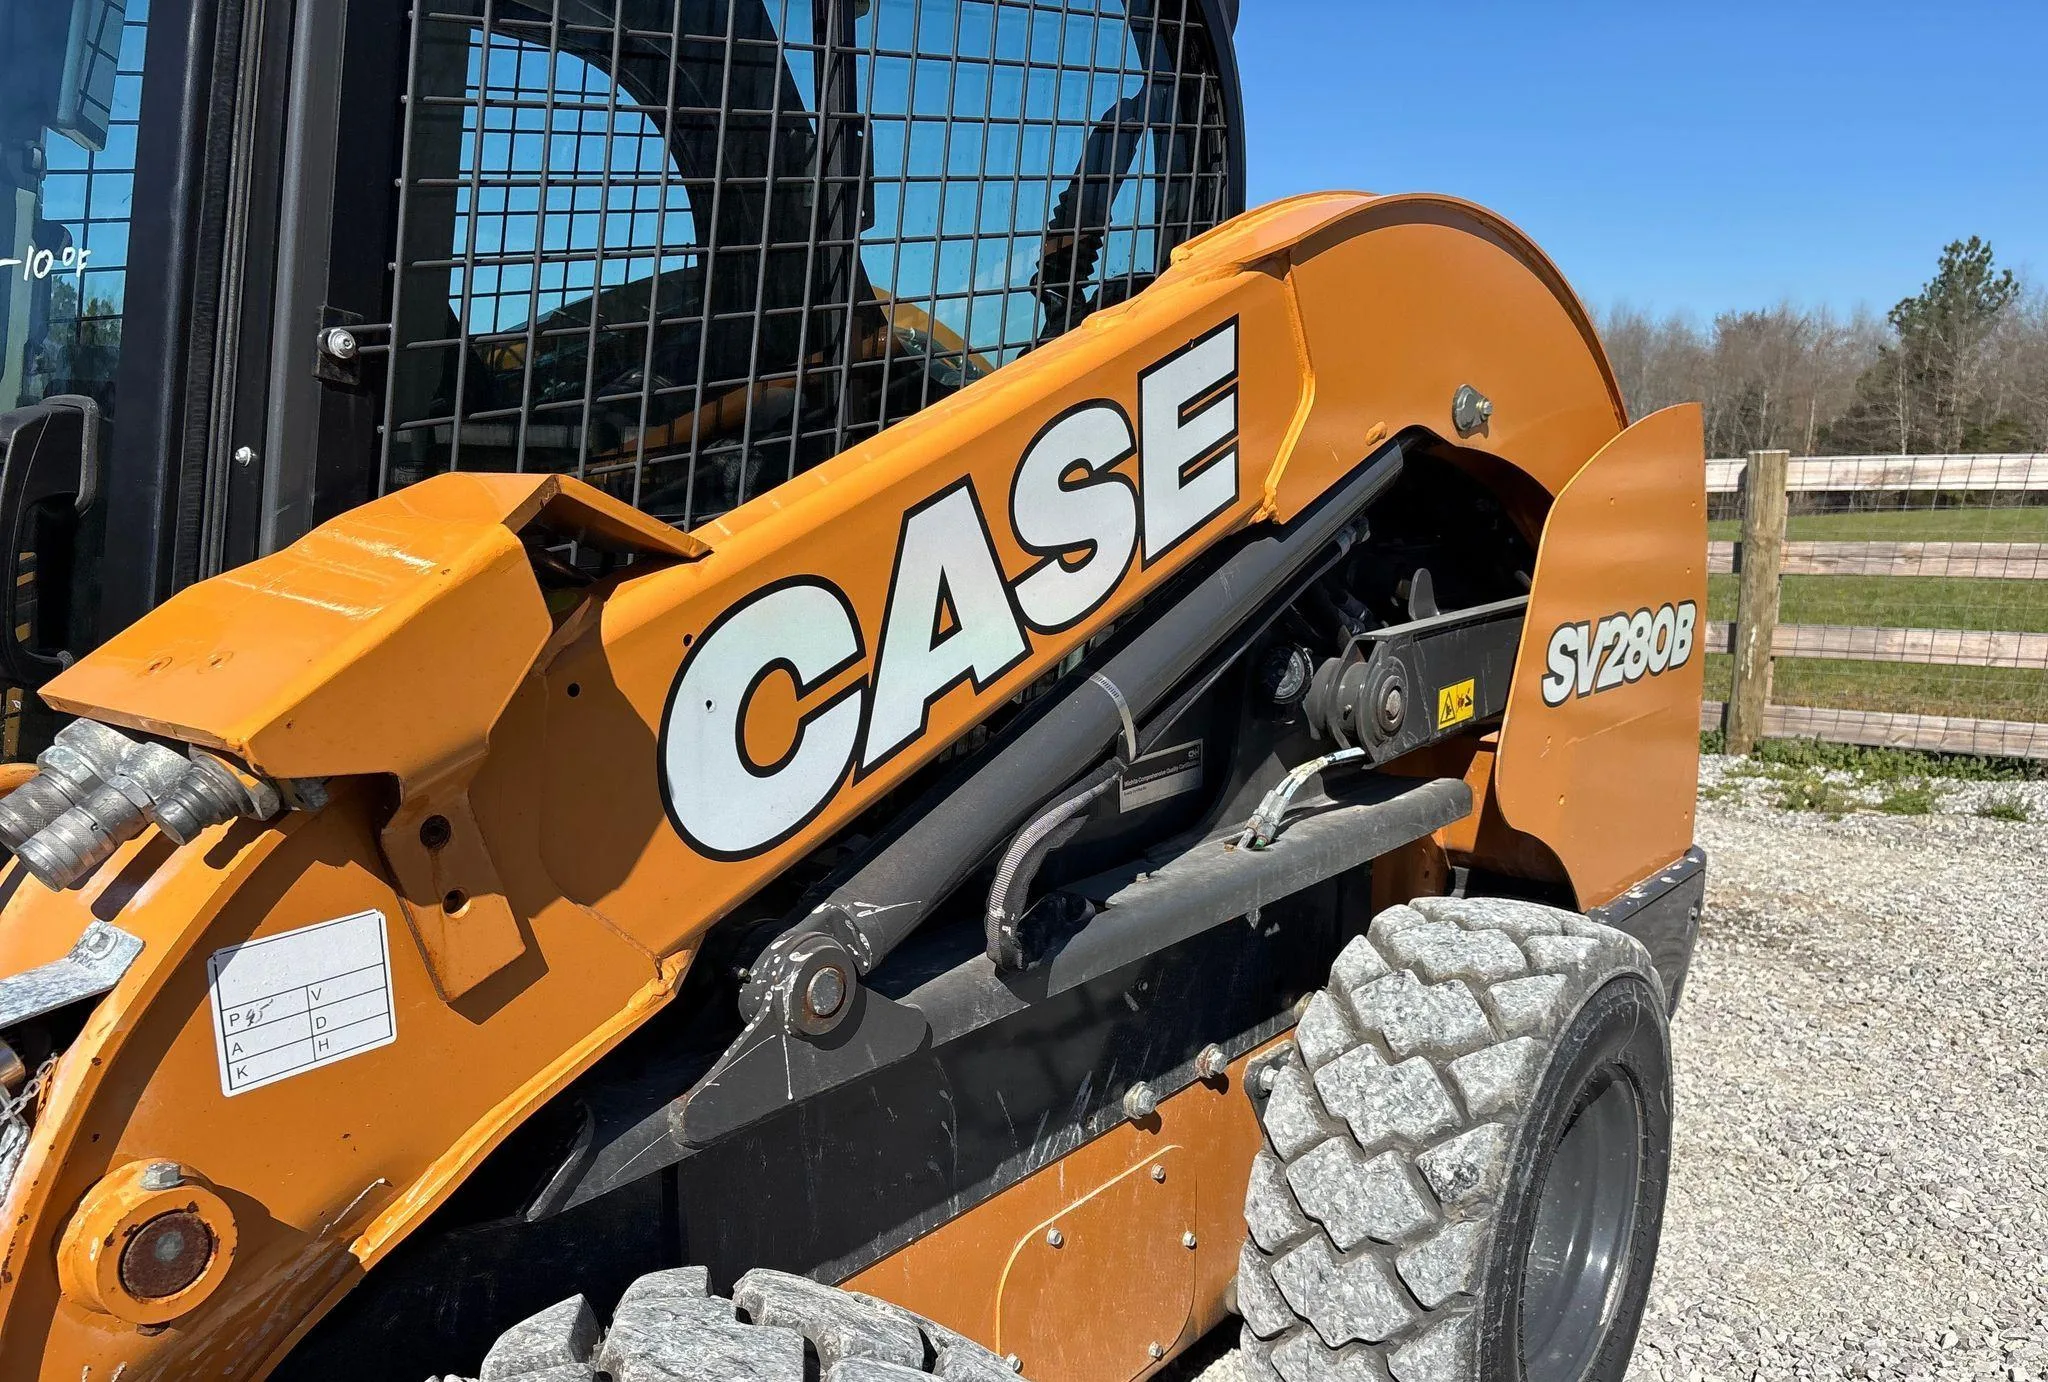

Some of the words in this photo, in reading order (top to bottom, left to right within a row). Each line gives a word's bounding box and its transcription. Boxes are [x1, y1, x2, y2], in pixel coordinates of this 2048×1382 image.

[657, 314, 1240, 862] CASE
[1541, 599, 1697, 708] SV280B
[311, 987, 322, 1001] V
[229, 1013, 240, 1027] P
[316, 1016, 327, 1030] D
[232, 1042, 244, 1056] A
[318, 1038, 330, 1052] H
[236, 1065, 248, 1080] K
